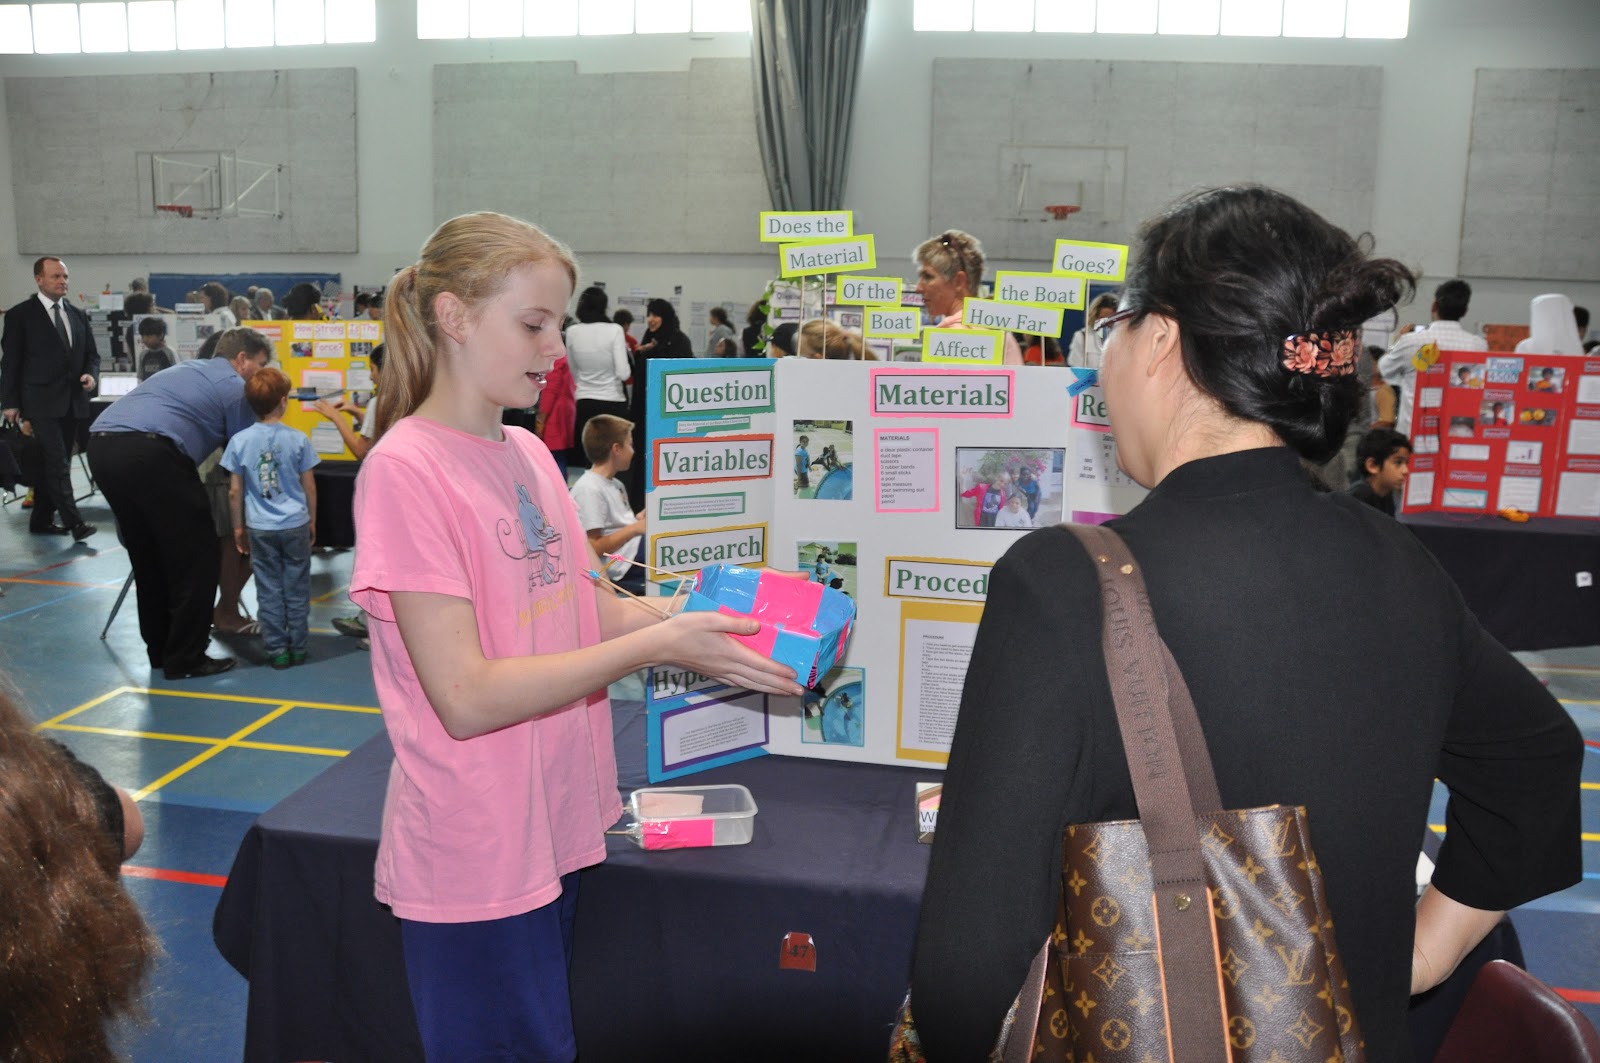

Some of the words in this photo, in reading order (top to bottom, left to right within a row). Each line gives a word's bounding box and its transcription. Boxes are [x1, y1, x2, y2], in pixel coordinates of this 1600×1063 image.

[769, 218, 812, 235] Does
[816, 218, 845, 234] the
[789, 245, 864, 270] Material
[1060, 254, 1115, 275] Goes?
[843, 283, 865, 299] Of
[868, 283, 896, 299] the
[1001, 285, 1031, 302] the
[1034, 286, 1076, 304] Boat
[315, 323, 344, 335] Strong
[361, 323, 378, 332] The
[871, 315, 913, 330] Boat
[969, 309, 1012, 329] How
[1015, 313, 1047, 332] Far
[933, 341, 987, 359] Affect
[667, 379, 768, 410] Question
[878, 383, 1008, 407] Materials
[663, 448, 768, 473] Variables
[660, 536, 761, 568] Research
[896, 568, 989, 595] Proced
[788, 944, 810, 959] 47
